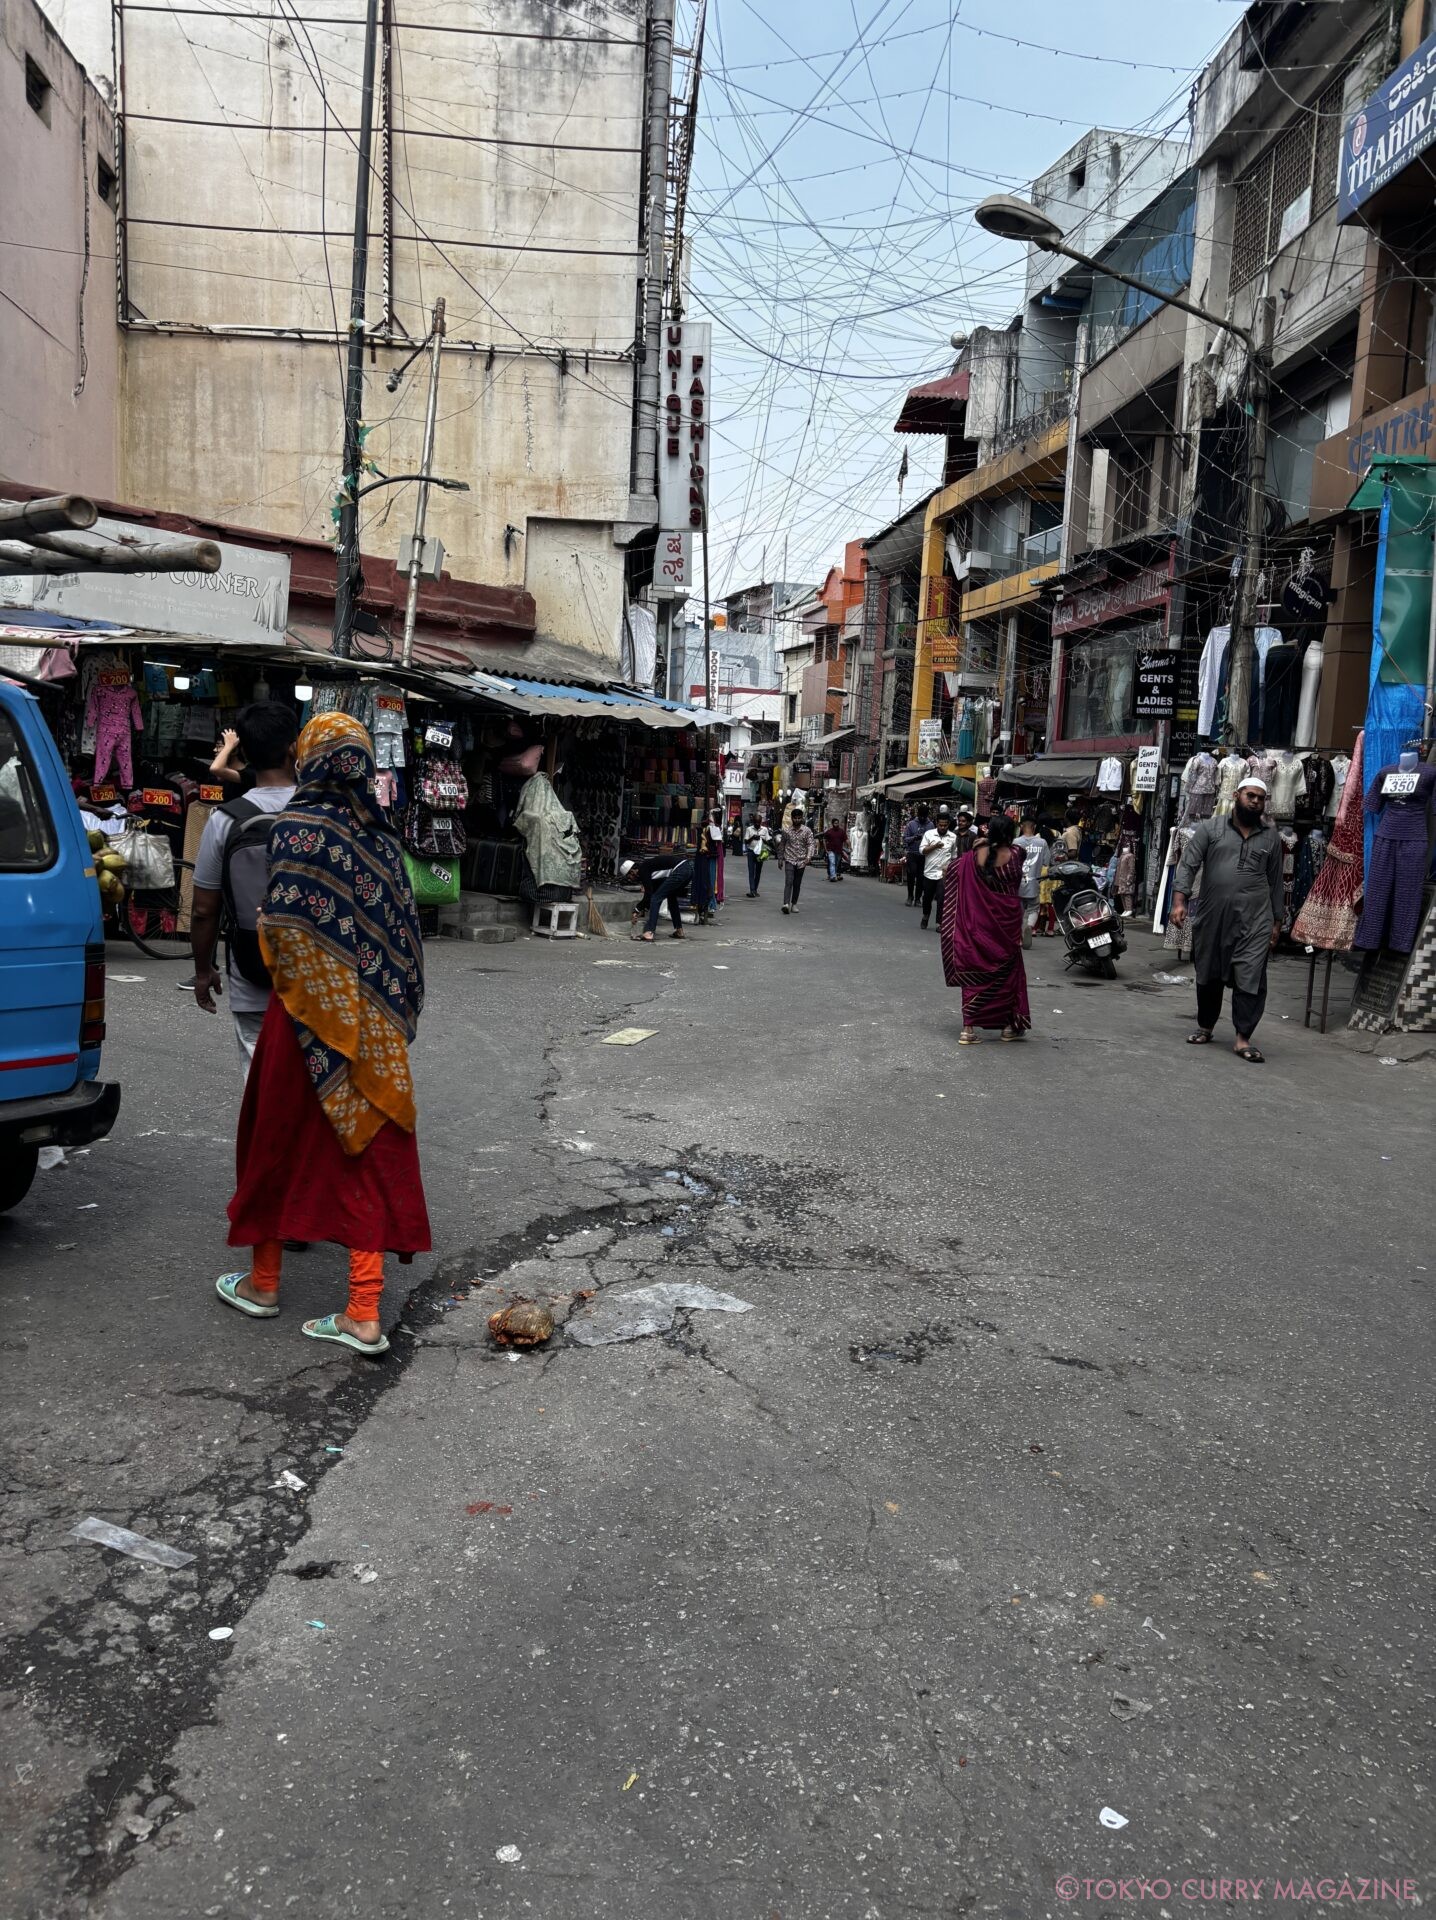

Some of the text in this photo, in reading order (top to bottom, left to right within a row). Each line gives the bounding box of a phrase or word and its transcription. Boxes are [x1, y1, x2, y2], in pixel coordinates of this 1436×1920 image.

[666, 326, 682, 456] UNIQUE
[689, 354, 704, 526] FASHIONS
[1348, 398, 1435, 474] CENTRE
[169, 571, 260, 598] CORNER
[1289, 581, 1322, 609] magicpin
[111, 675, 128, 686] 200
[1140, 674, 1174, 684] GENTS
[1151, 685, 1160, 694] &
[386, 701, 401, 711] 200
[1136, 696, 1173, 706] LADIES
[430, 733, 451, 746] 60
[1171, 731, 1198, 740] JOCKE
[1138, 761, 1158, 769] GENTS
[442, 785, 458, 795] 100
[1390, 780, 1416, 792] 350
[100, 790, 115, 801] 250
[153, 795, 169, 806] 200
[436, 819, 451, 829] 100
[433, 867, 451, 883] 80
